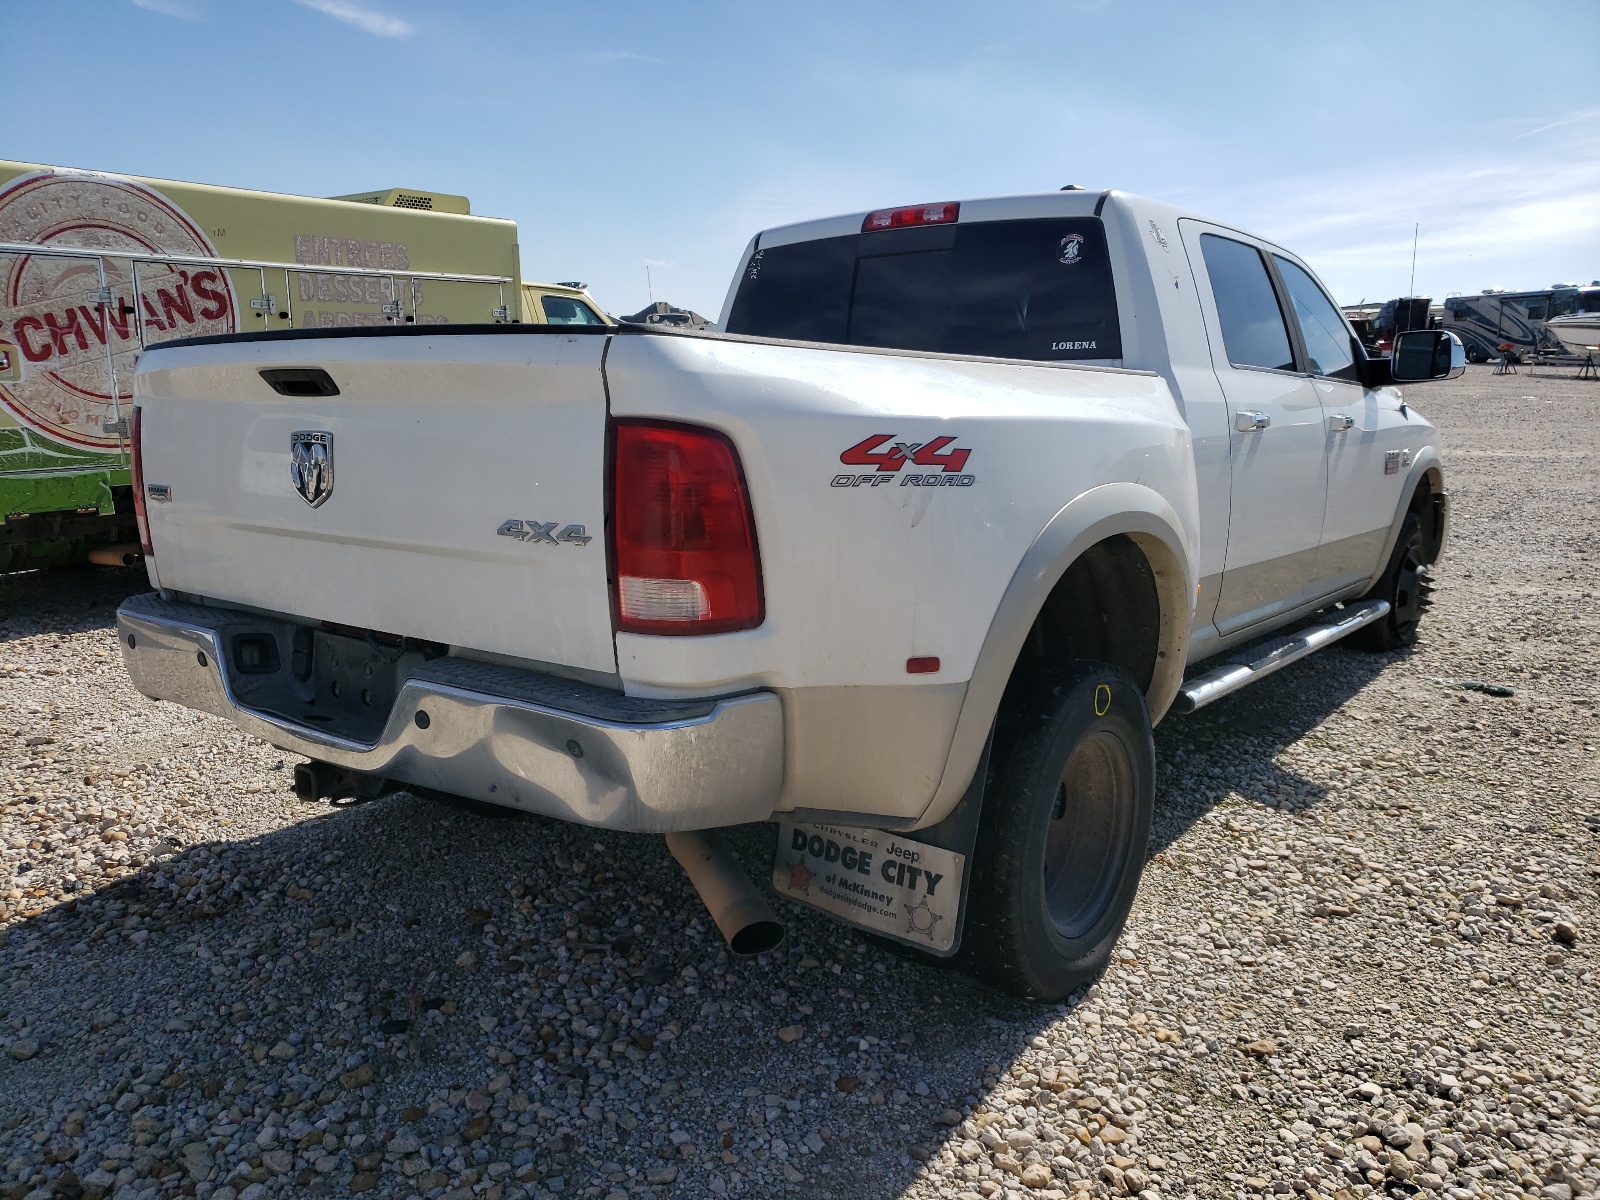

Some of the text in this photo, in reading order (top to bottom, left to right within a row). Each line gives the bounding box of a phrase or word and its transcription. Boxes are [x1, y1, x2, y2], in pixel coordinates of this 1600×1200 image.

[294, 234, 410, 270] ENTREES
[1051, 340, 1097, 351] LORENA
[293, 433, 327, 443] DODGE
[830, 474, 976, 488] OFF ROAD
[813, 823, 879, 848] CHRYSLER
[792, 829, 944, 896] DODGE CITY
[819, 886, 898, 920] dodgecitydodge.com
[825, 873, 894, 907] of McKinney
